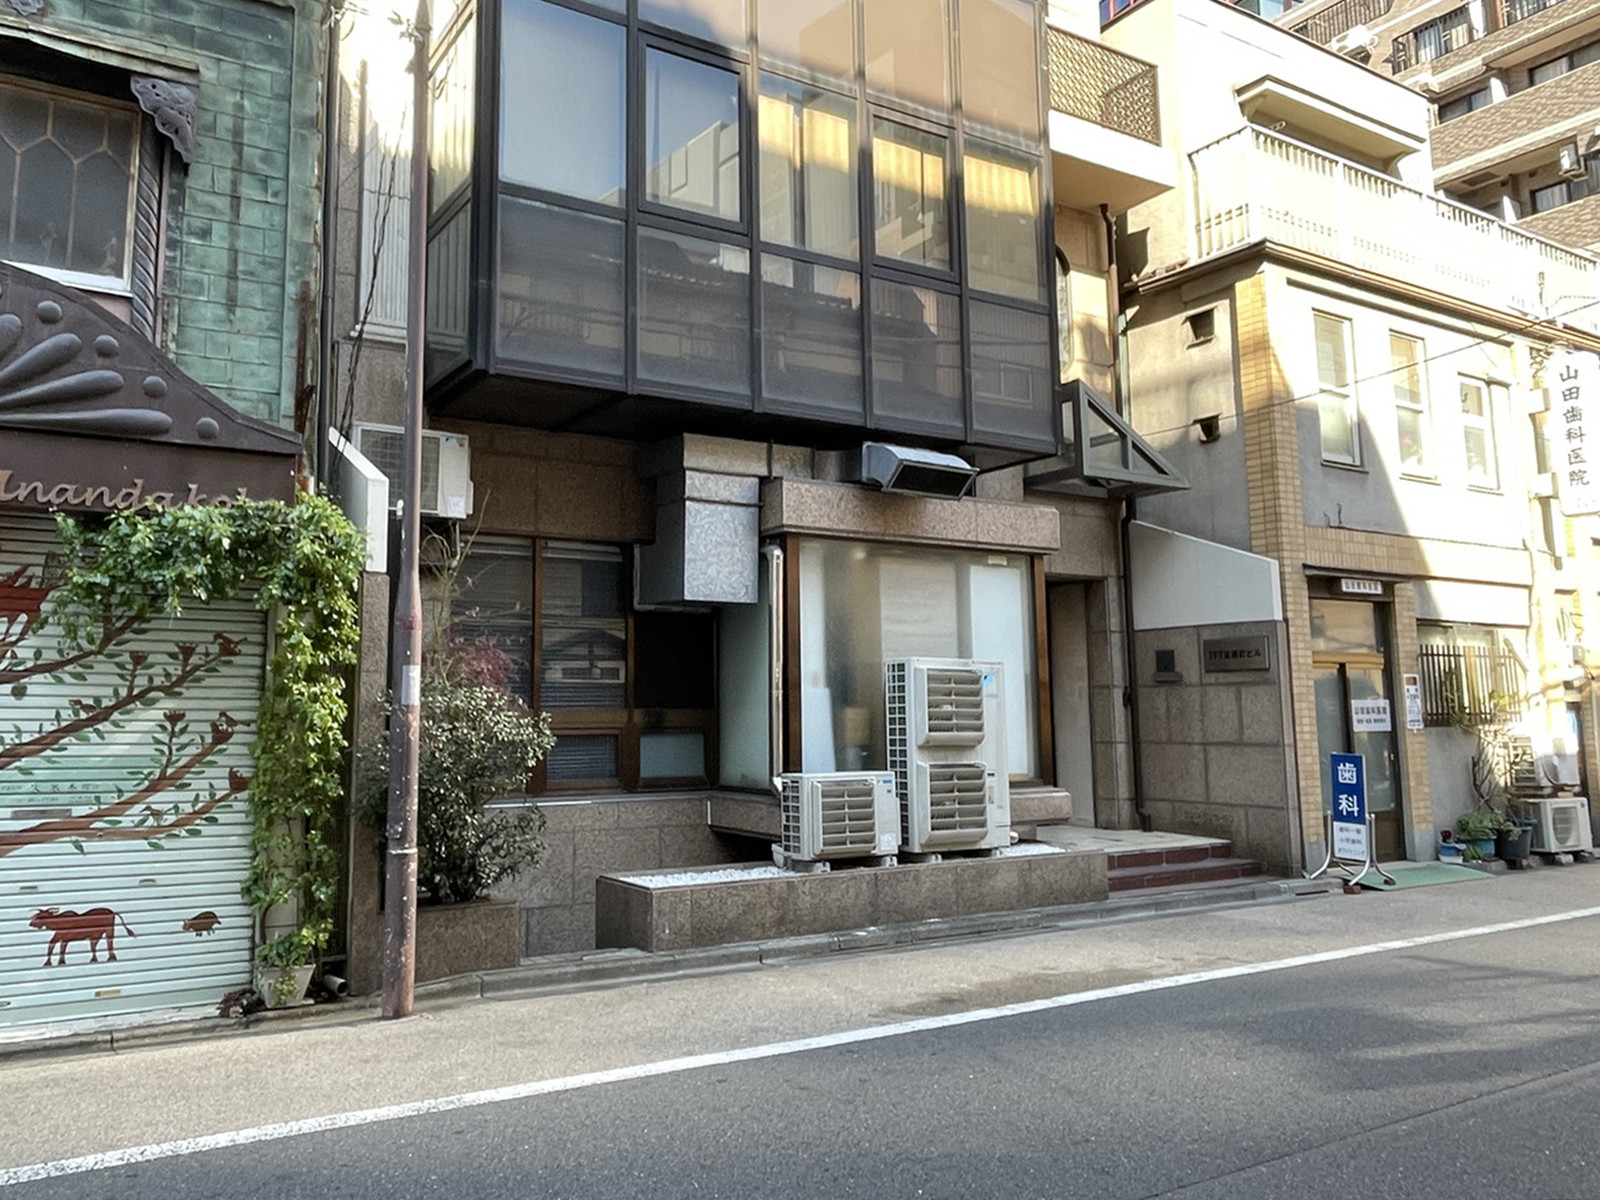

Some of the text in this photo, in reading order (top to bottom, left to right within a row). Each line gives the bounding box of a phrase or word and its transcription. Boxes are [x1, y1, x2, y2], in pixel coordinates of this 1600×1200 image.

[1559, 365, 1590, 487] 山田歯科医院
[1337, 762, 1360, 817] 歯科
